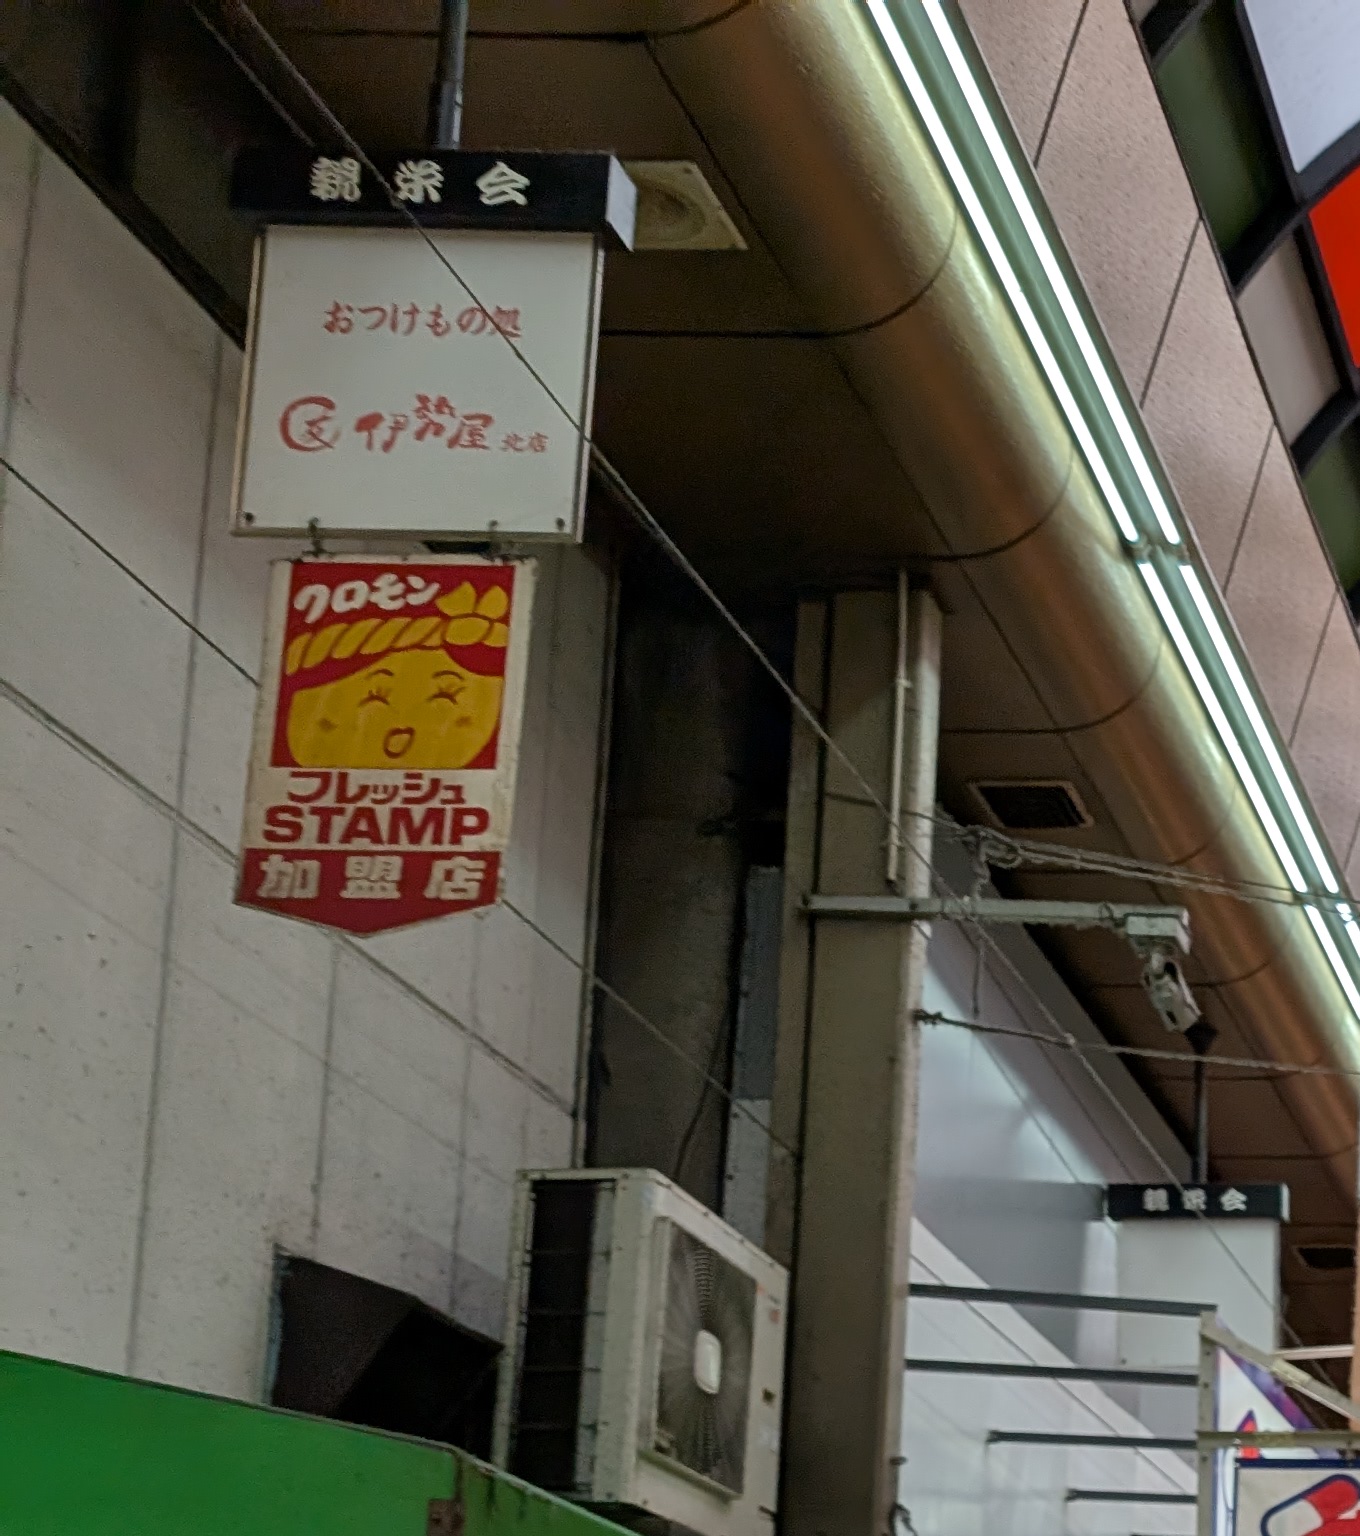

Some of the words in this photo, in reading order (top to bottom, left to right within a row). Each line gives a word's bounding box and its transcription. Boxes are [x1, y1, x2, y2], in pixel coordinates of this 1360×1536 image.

[325, 301, 522, 339] おつけもの処
[294, 573, 440, 625] クロモン
[288, 771, 467, 805] フレッシュ
[263, 804, 490, 847] STAMP
[257, 854, 488, 901] 加盟店
